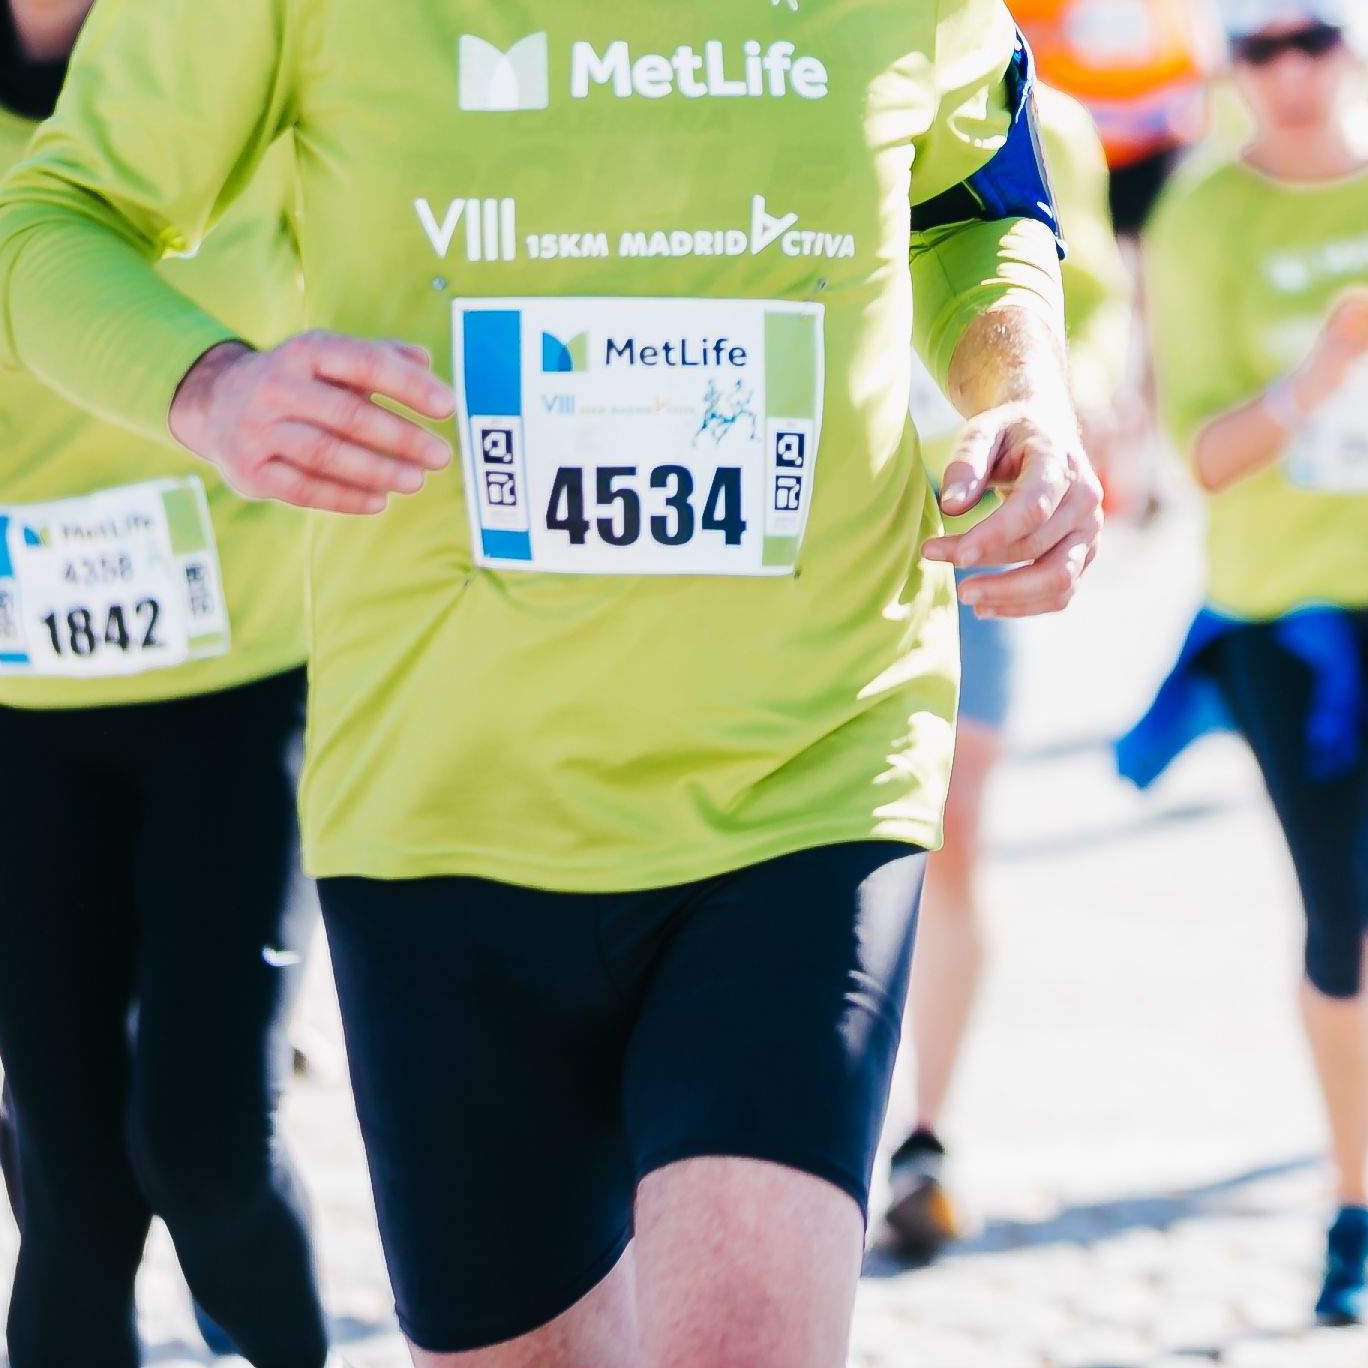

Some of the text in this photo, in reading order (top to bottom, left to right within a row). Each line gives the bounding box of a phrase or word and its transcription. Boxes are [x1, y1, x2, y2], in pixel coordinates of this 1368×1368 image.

[571, 40, 829, 99] MetLife
[413, 197, 517, 263] VIII
[525, 232, 610, 260] 15KM
[605, 338, 748, 368] MetLife
[545, 464, 748, 547] 4534
[44, 597, 168, 657] 1842
